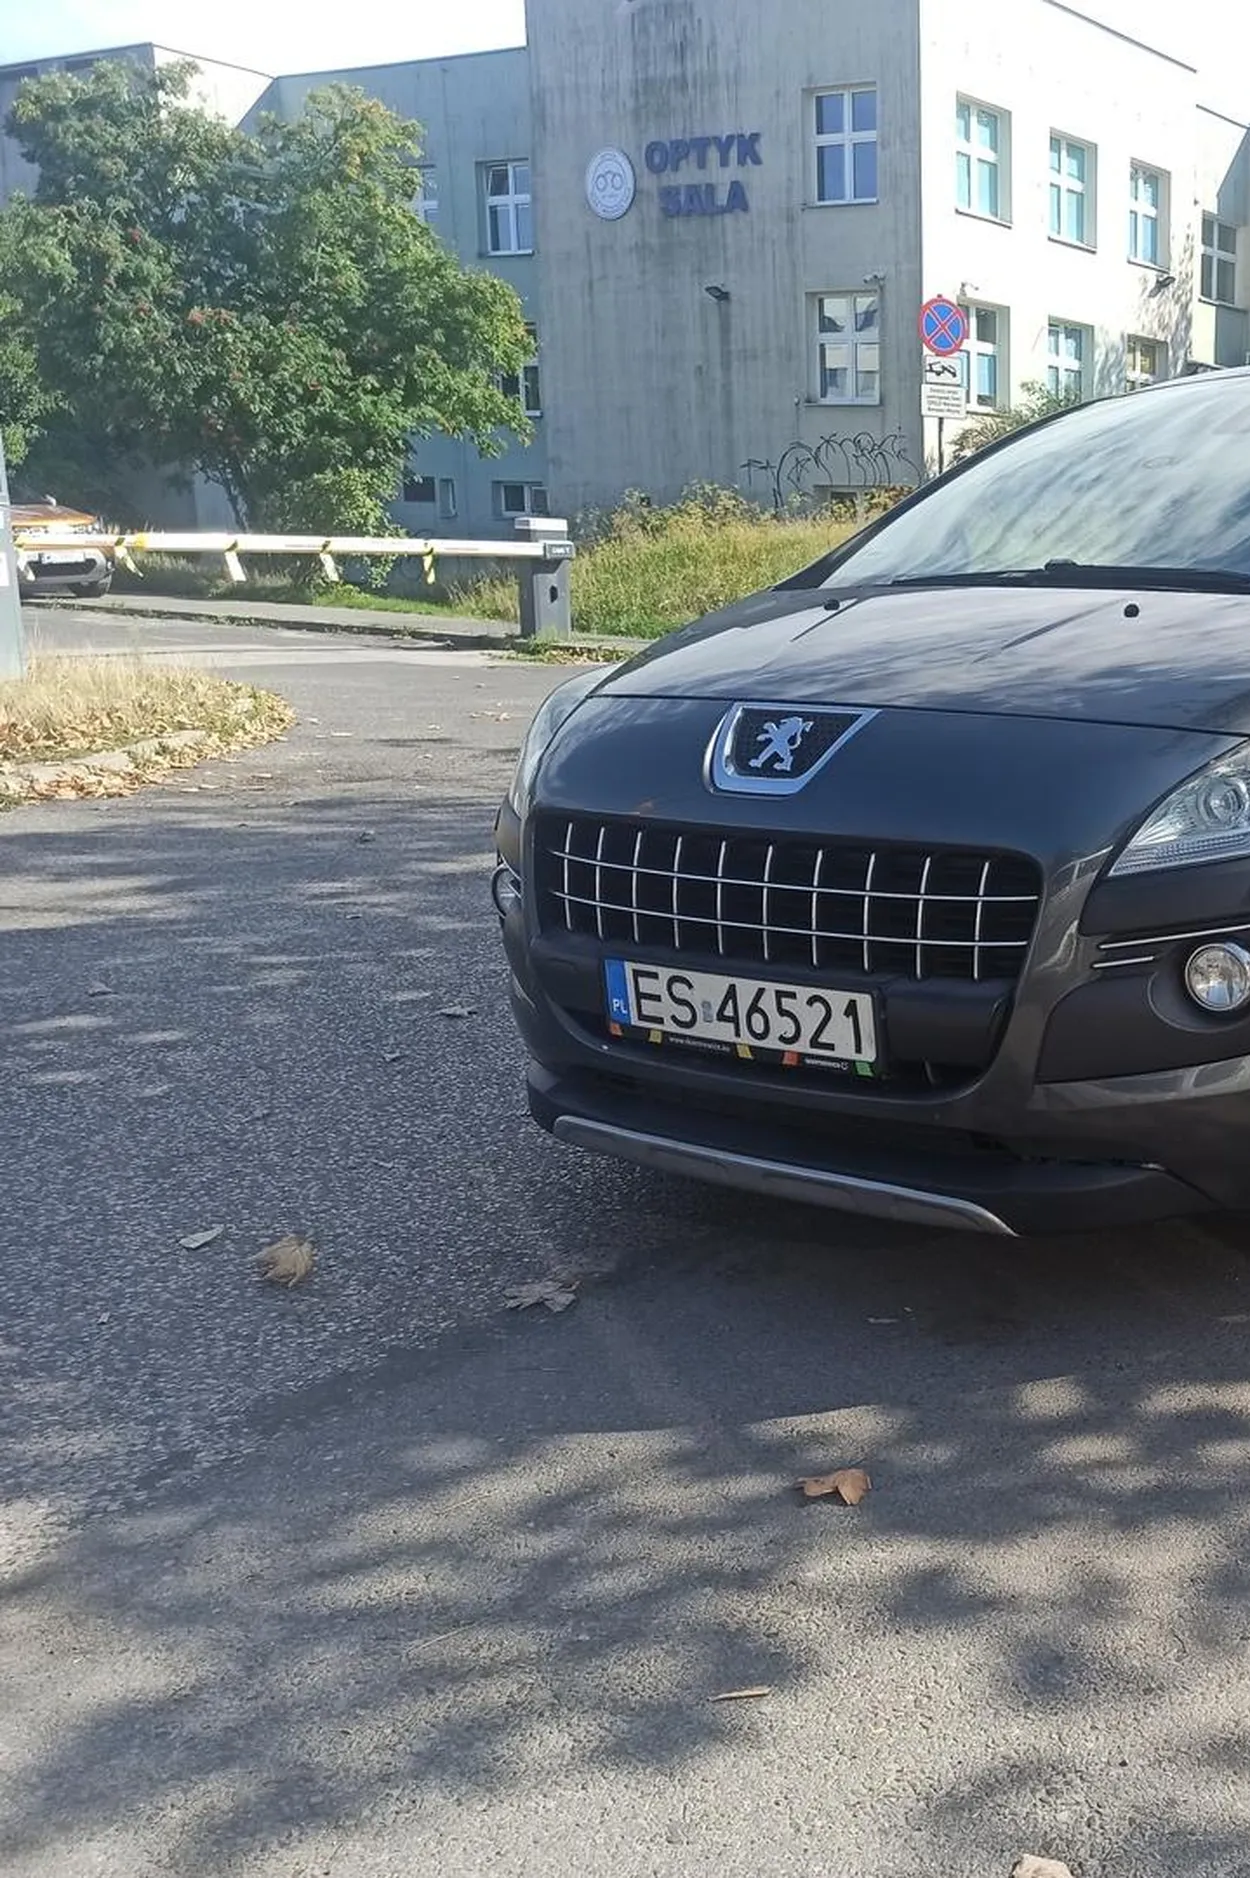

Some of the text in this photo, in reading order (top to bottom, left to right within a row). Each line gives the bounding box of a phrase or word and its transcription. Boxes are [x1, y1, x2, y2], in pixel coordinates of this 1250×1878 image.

[645, 132, 763, 174] OPTYK
[659, 180, 749, 217] SALA
[612, 999, 628, 1015] PL
[631, 968, 863, 1055] ES 46521
